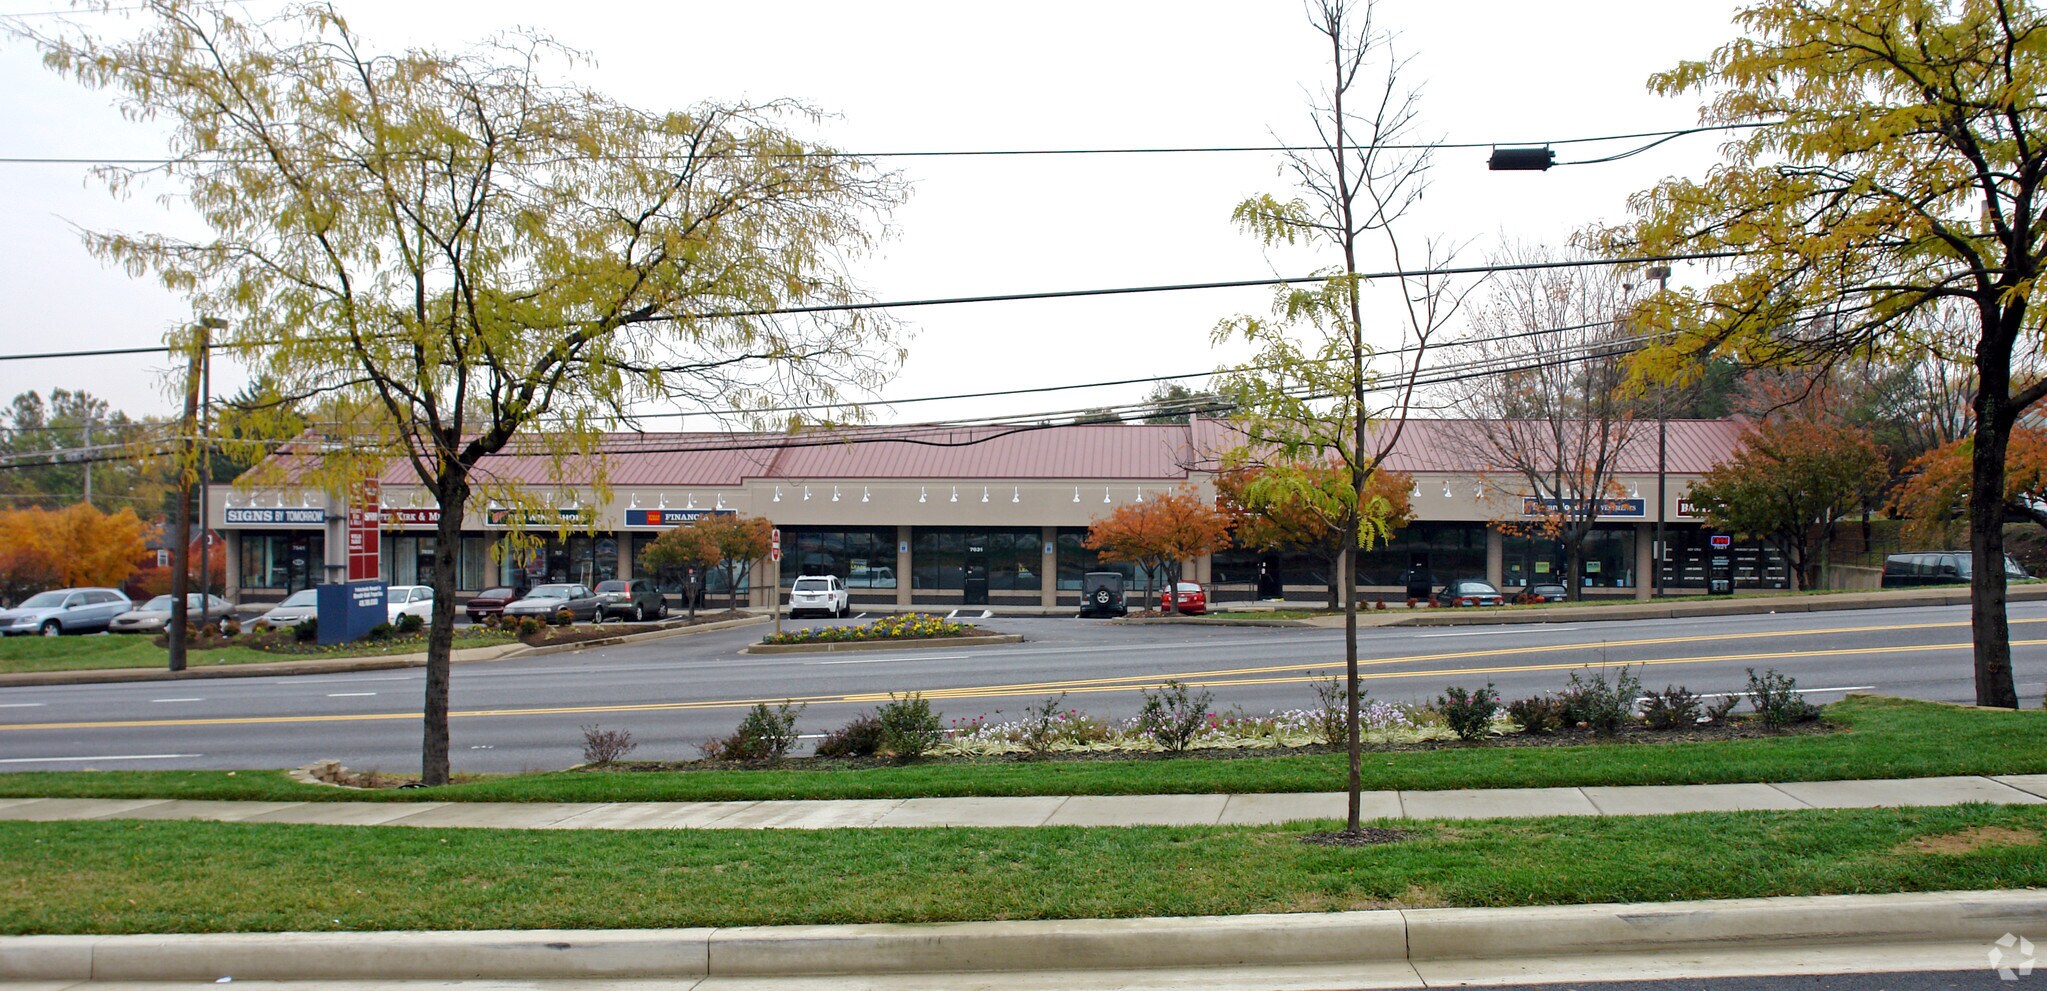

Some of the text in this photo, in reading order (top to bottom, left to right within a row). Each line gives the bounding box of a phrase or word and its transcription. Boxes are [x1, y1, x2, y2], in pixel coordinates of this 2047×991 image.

[227, 510, 324, 522] SIGNS BY TOMORROW
[418, 512, 425, 521] &
